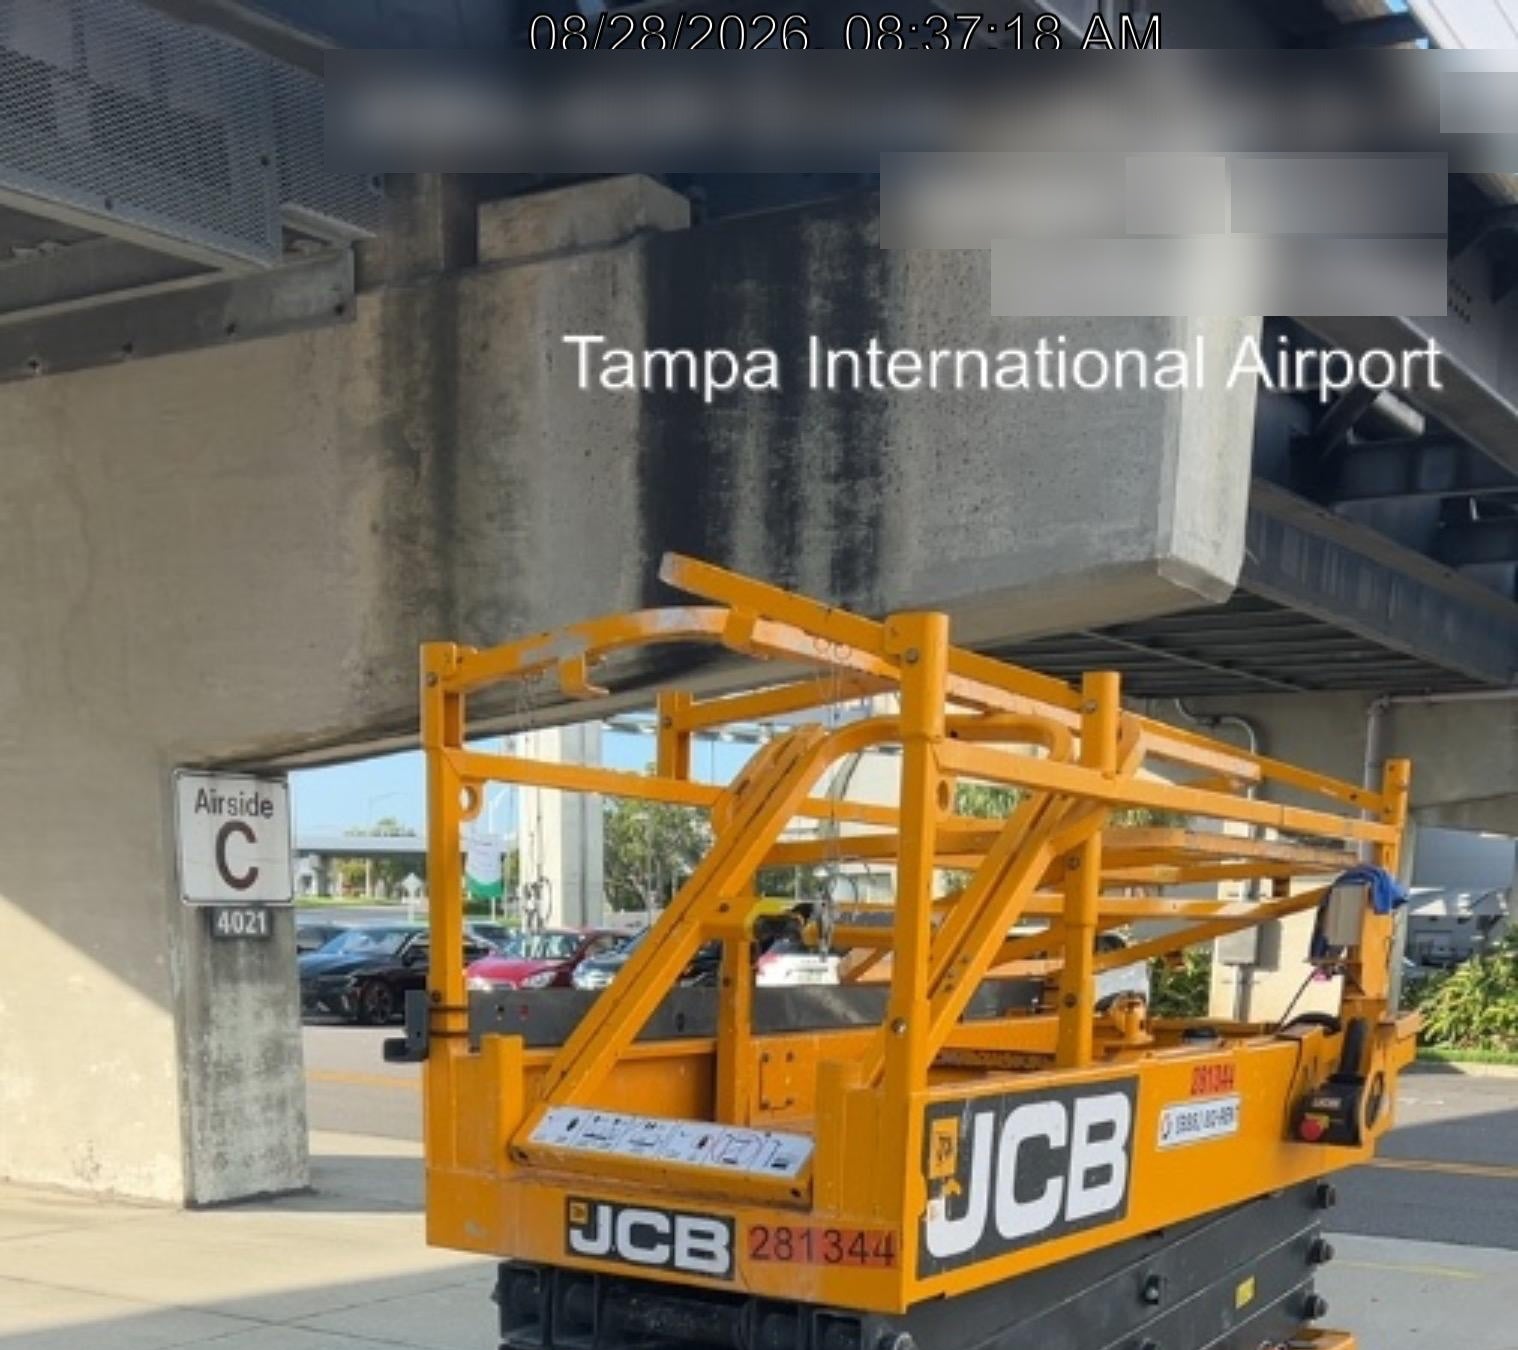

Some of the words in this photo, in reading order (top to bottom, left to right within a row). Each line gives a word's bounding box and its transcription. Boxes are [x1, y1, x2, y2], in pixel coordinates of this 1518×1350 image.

[194, 787, 275, 819] Airside
[215, 820, 260, 889] C
[216, 909, 267, 935] 4021
[926, 1091, 1131, 1258] JCB
[569, 1204, 731, 1274] JCB
[749, 1225, 896, 1266] 281344
